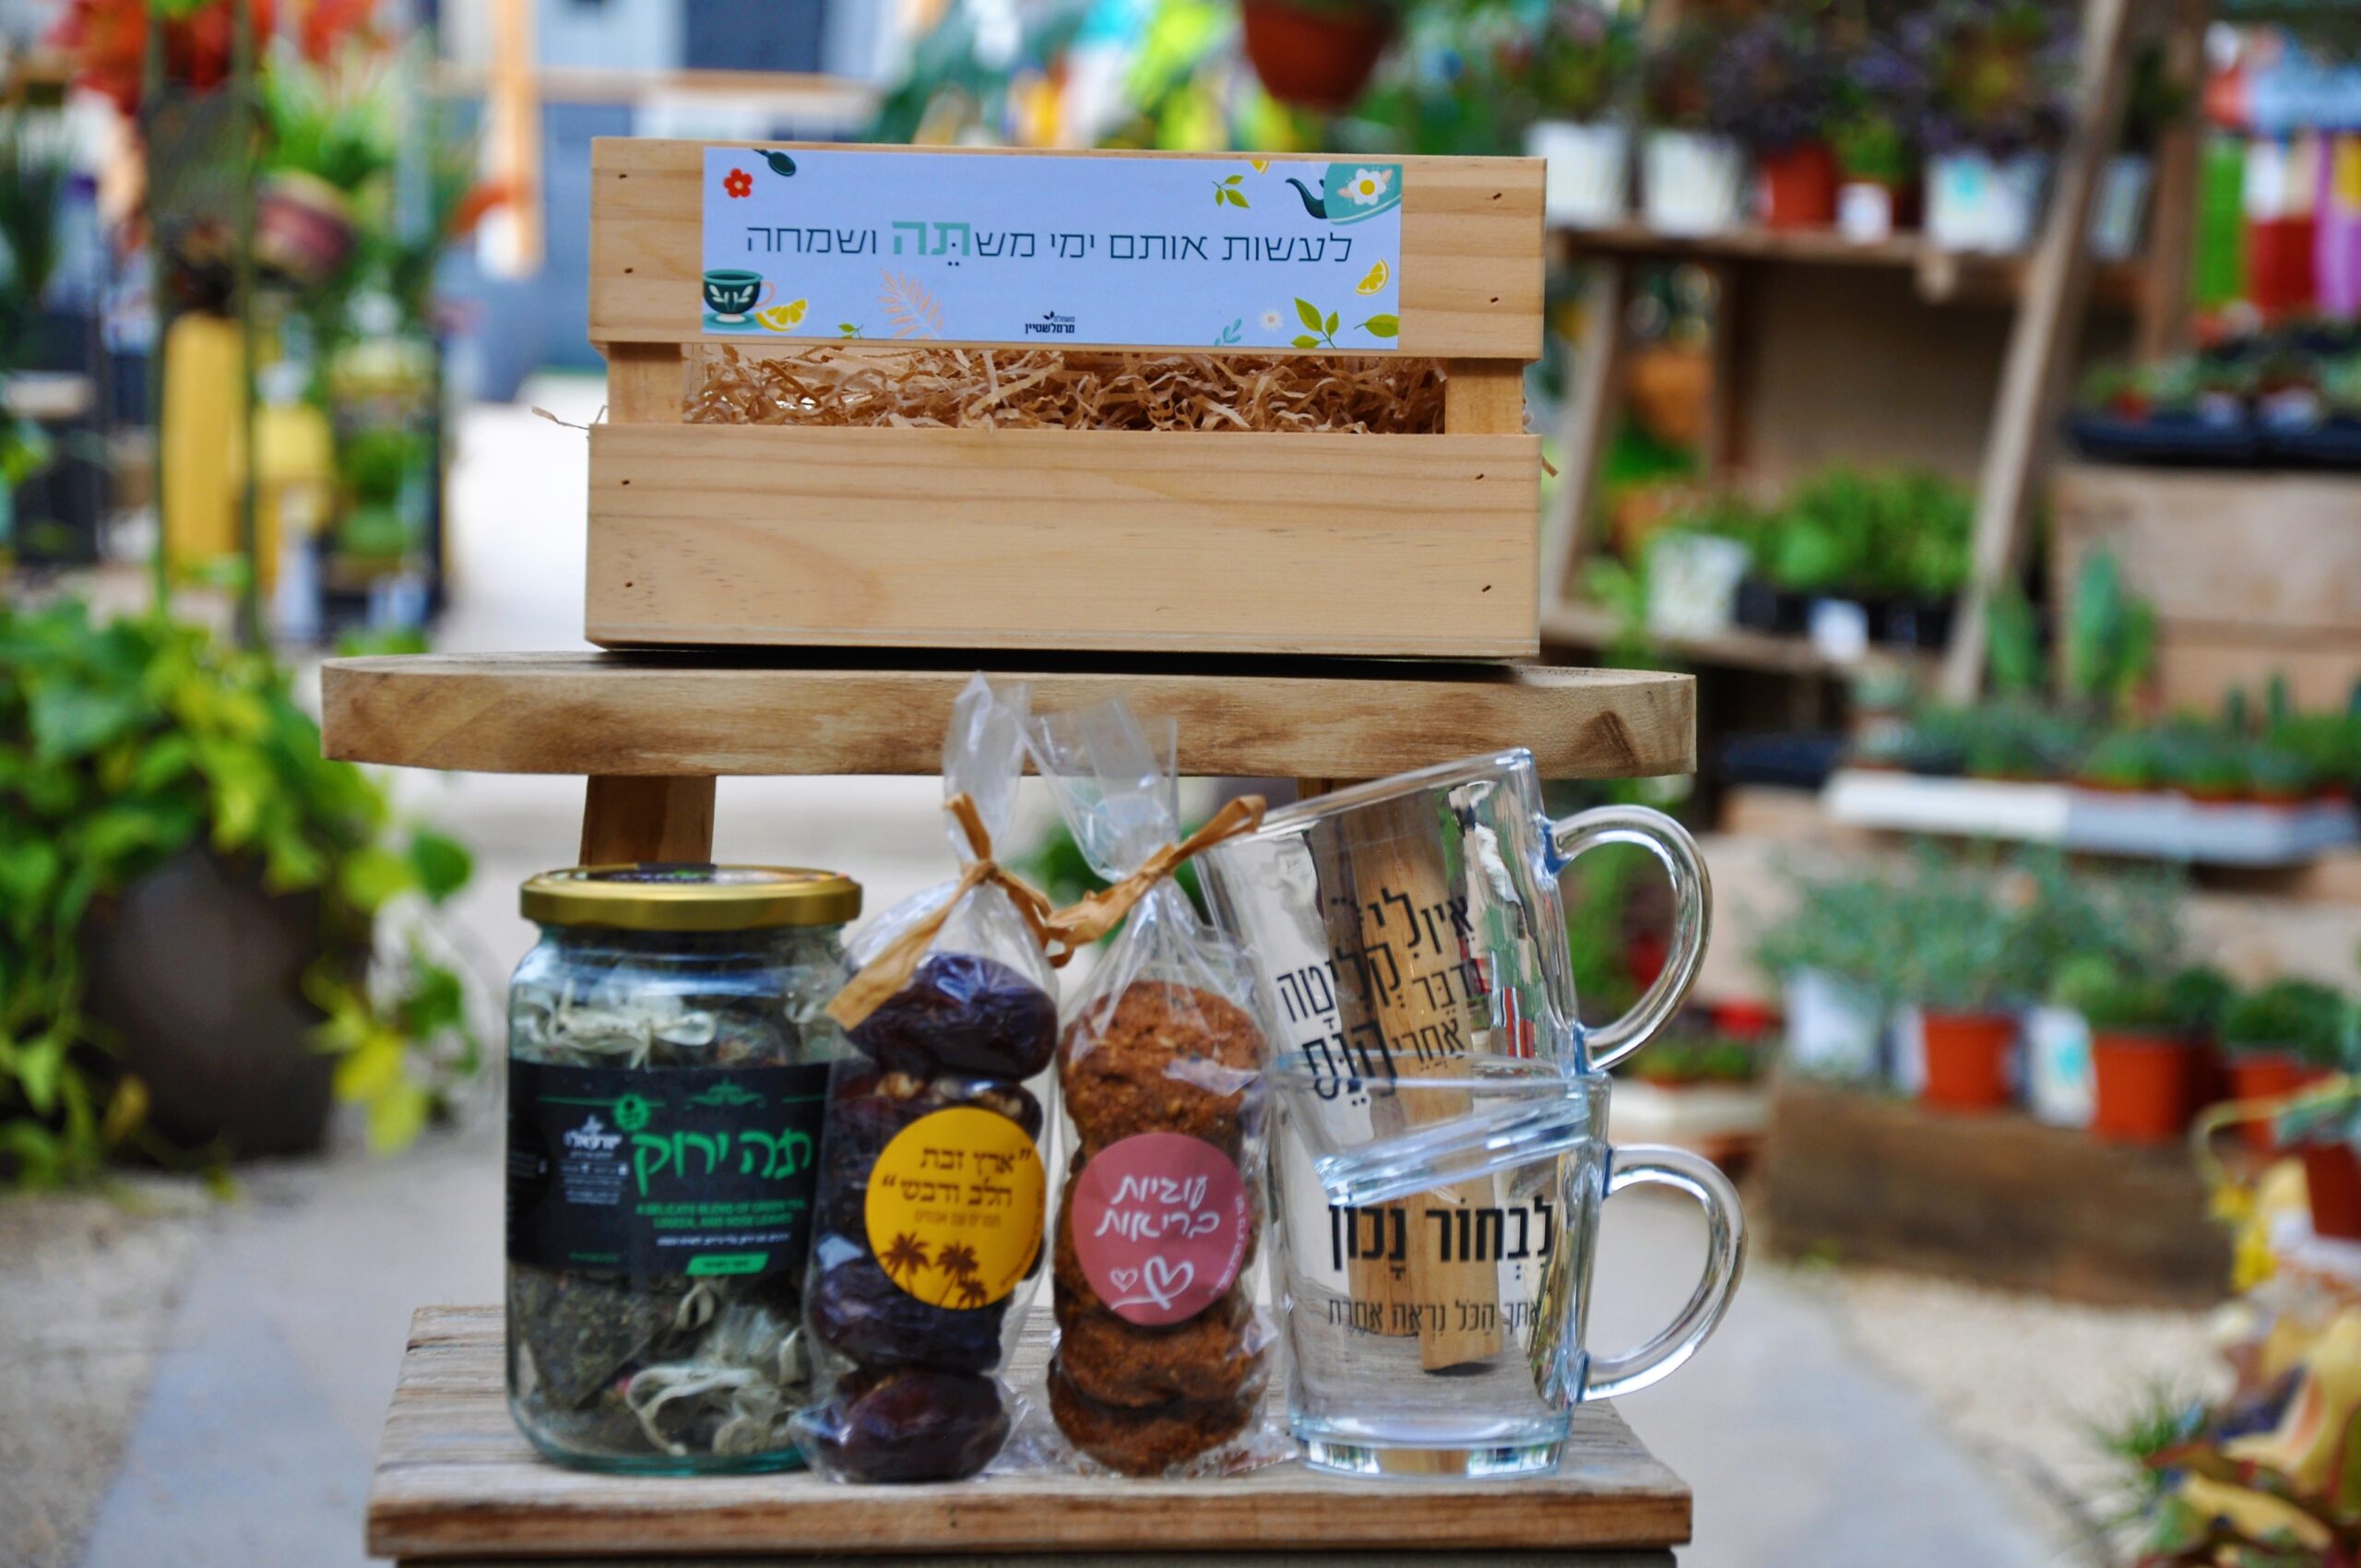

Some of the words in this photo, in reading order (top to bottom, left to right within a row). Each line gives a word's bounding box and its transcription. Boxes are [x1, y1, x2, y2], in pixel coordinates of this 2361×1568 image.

[746, 225, 877, 255] ושמחה
[1050, 232, 1096, 259] ימי
[1109, 234, 1208, 261] אותם
[1221, 227, 1353, 263] לעשות
[631, 1131, 730, 1198] ירוק
[739, 1128, 813, 1181] תה
[919, 1147, 965, 1170] זבת
[967, 1177, 1014, 1207] חלב
[1110, 1174, 1209, 1209] עוגיות
[1095, 1209, 1220, 1242] בריאות
